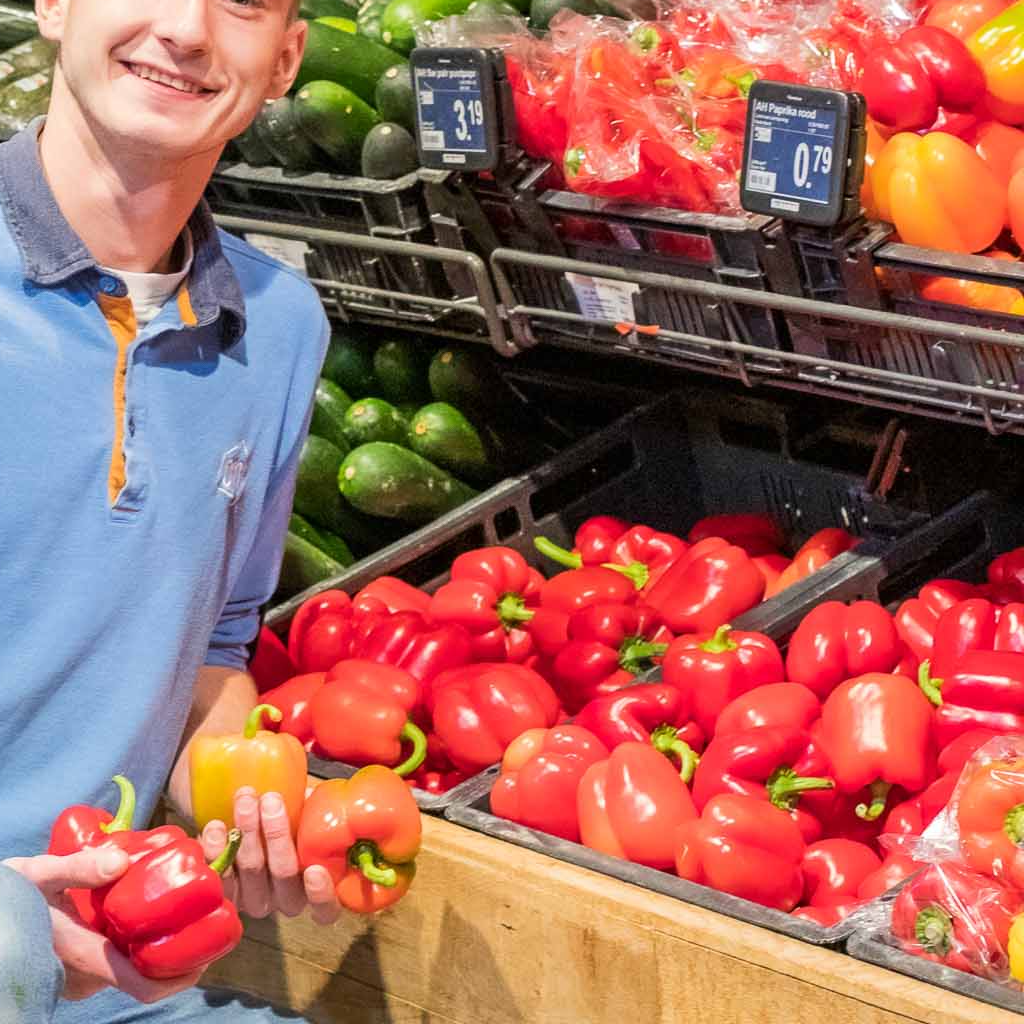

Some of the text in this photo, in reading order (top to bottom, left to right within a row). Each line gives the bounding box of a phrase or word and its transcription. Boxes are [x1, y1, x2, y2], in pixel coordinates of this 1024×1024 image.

[453, 99, 484, 141] 3.19
[755, 101, 817, 120] AH Paprika rood
[793, 142, 833, 189] 0.79
